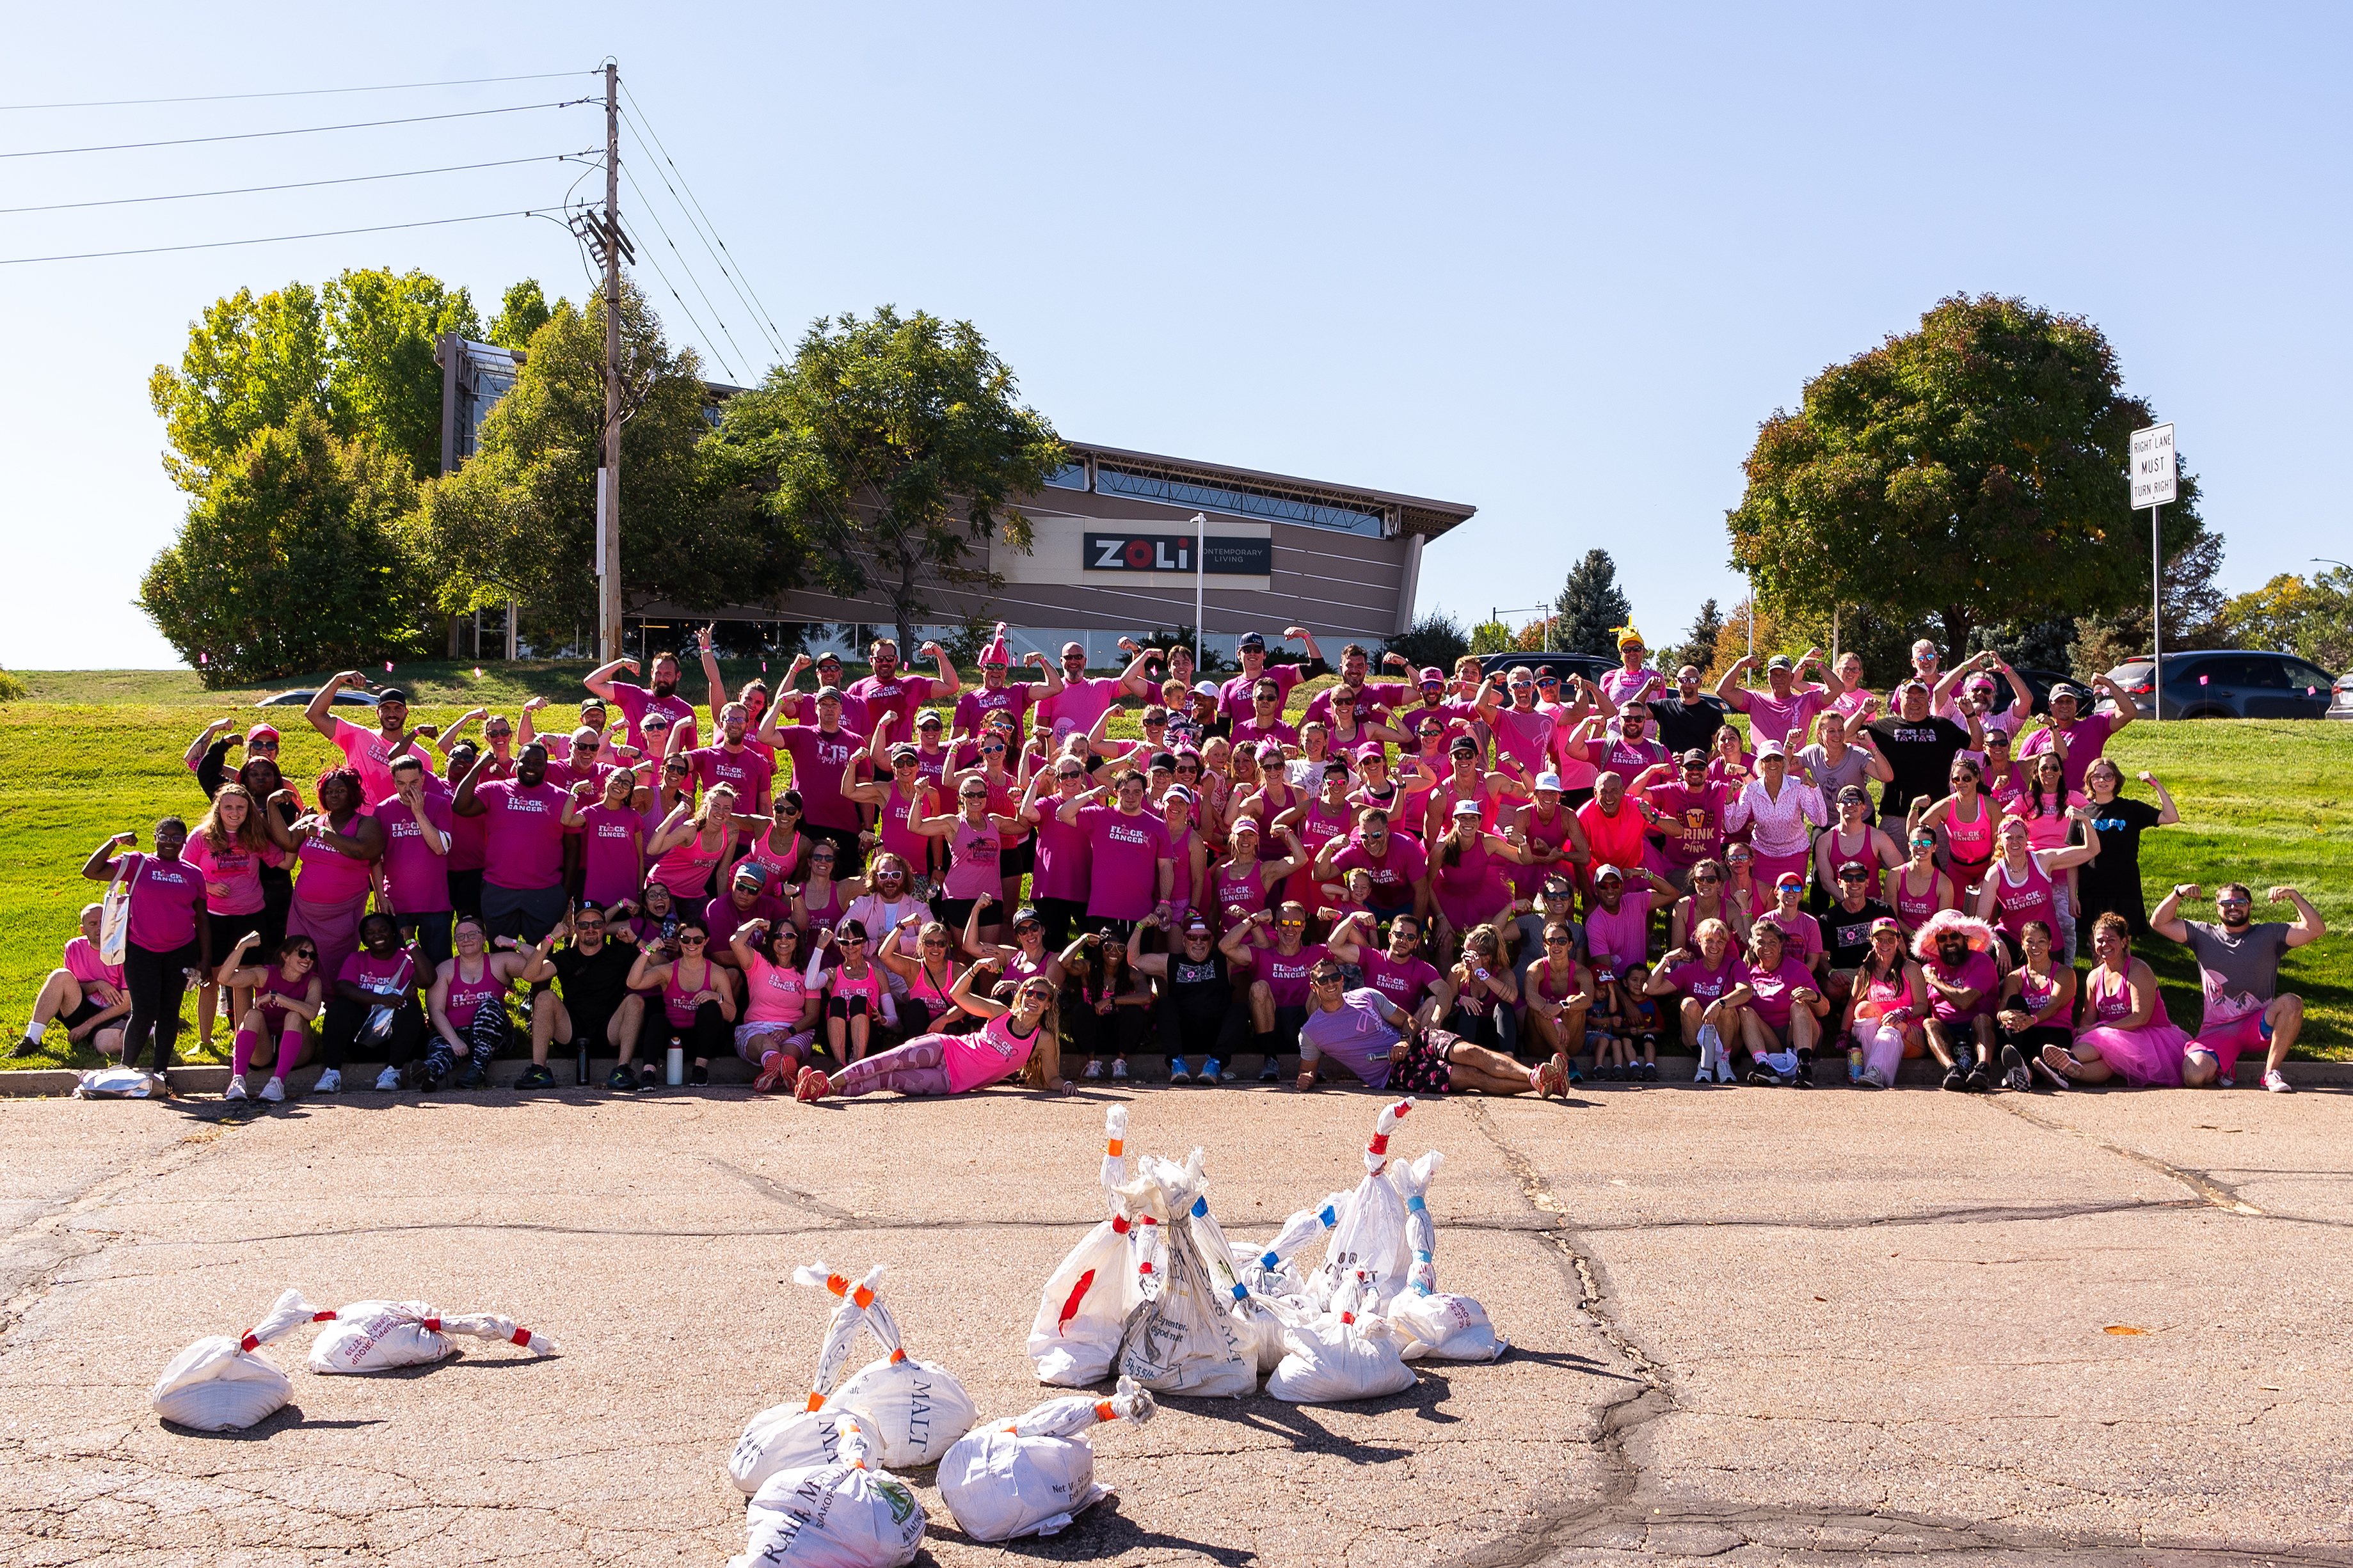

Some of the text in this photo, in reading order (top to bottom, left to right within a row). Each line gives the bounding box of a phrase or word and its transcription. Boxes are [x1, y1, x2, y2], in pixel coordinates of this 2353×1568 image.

[2134, 434, 2171, 454] RIGHT LANE
[2141, 456, 2164, 475] MUST
[2134, 479, 2173, 498] TURN RIGHT
[1202, 548, 1263, 557] ONTEMPORARY
[716, 770, 742, 779] CANCER
[1110, 833, 1144, 844] CANCER
[1675, 827, 1715, 840] RINK
[1682, 842, 1707, 853] PINK
[2008, 899, 2042, 911] CANCER
[1272, 970, 1306, 978] CANCER
[1376, 981, 1405, 992] CANCER
[909, 1378, 932, 1453] MALT
[1051, 1485, 1066, 1494] Net
